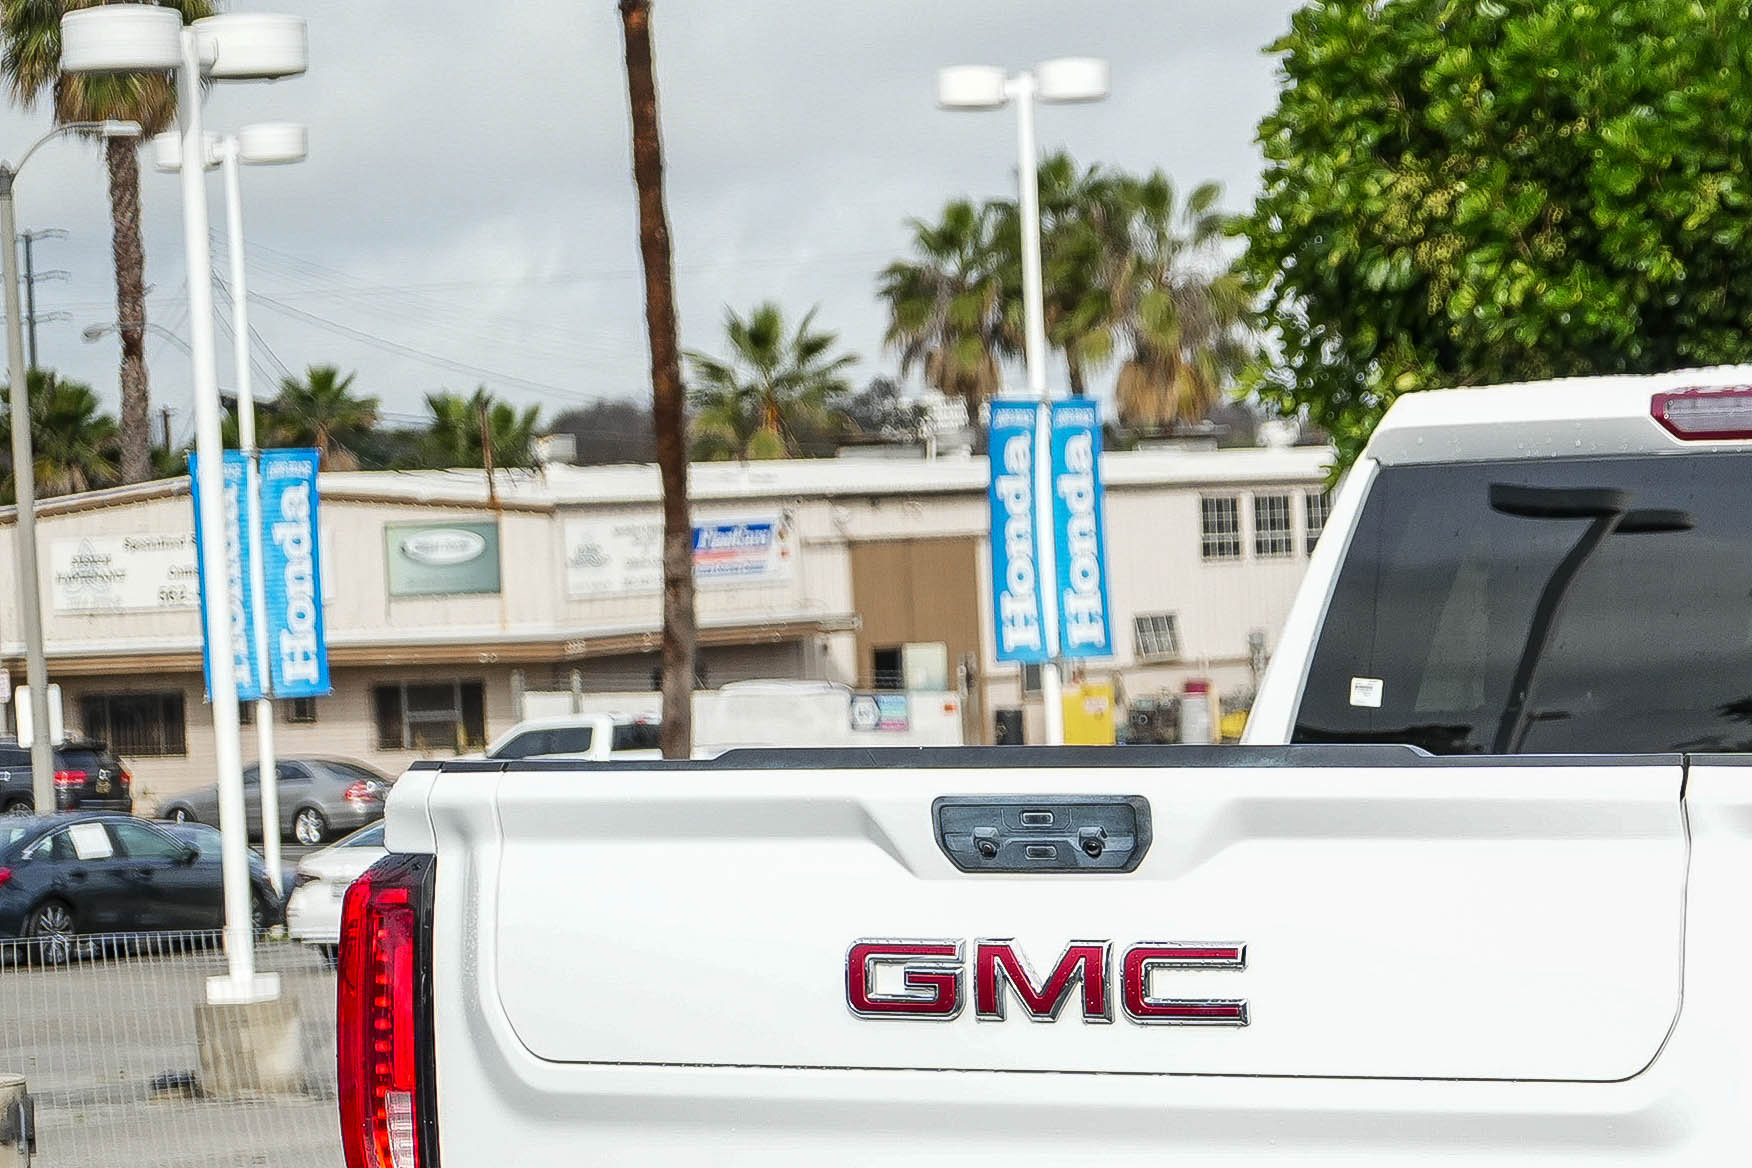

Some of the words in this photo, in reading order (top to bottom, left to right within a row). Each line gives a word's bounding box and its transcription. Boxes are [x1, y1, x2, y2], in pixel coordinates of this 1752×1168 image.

[272, 479, 320, 686] Honda
[995, 430, 1042, 653] Honda
[1056, 429, 1106, 649] Honda
[845, 936, 1250, 1027] GMC
